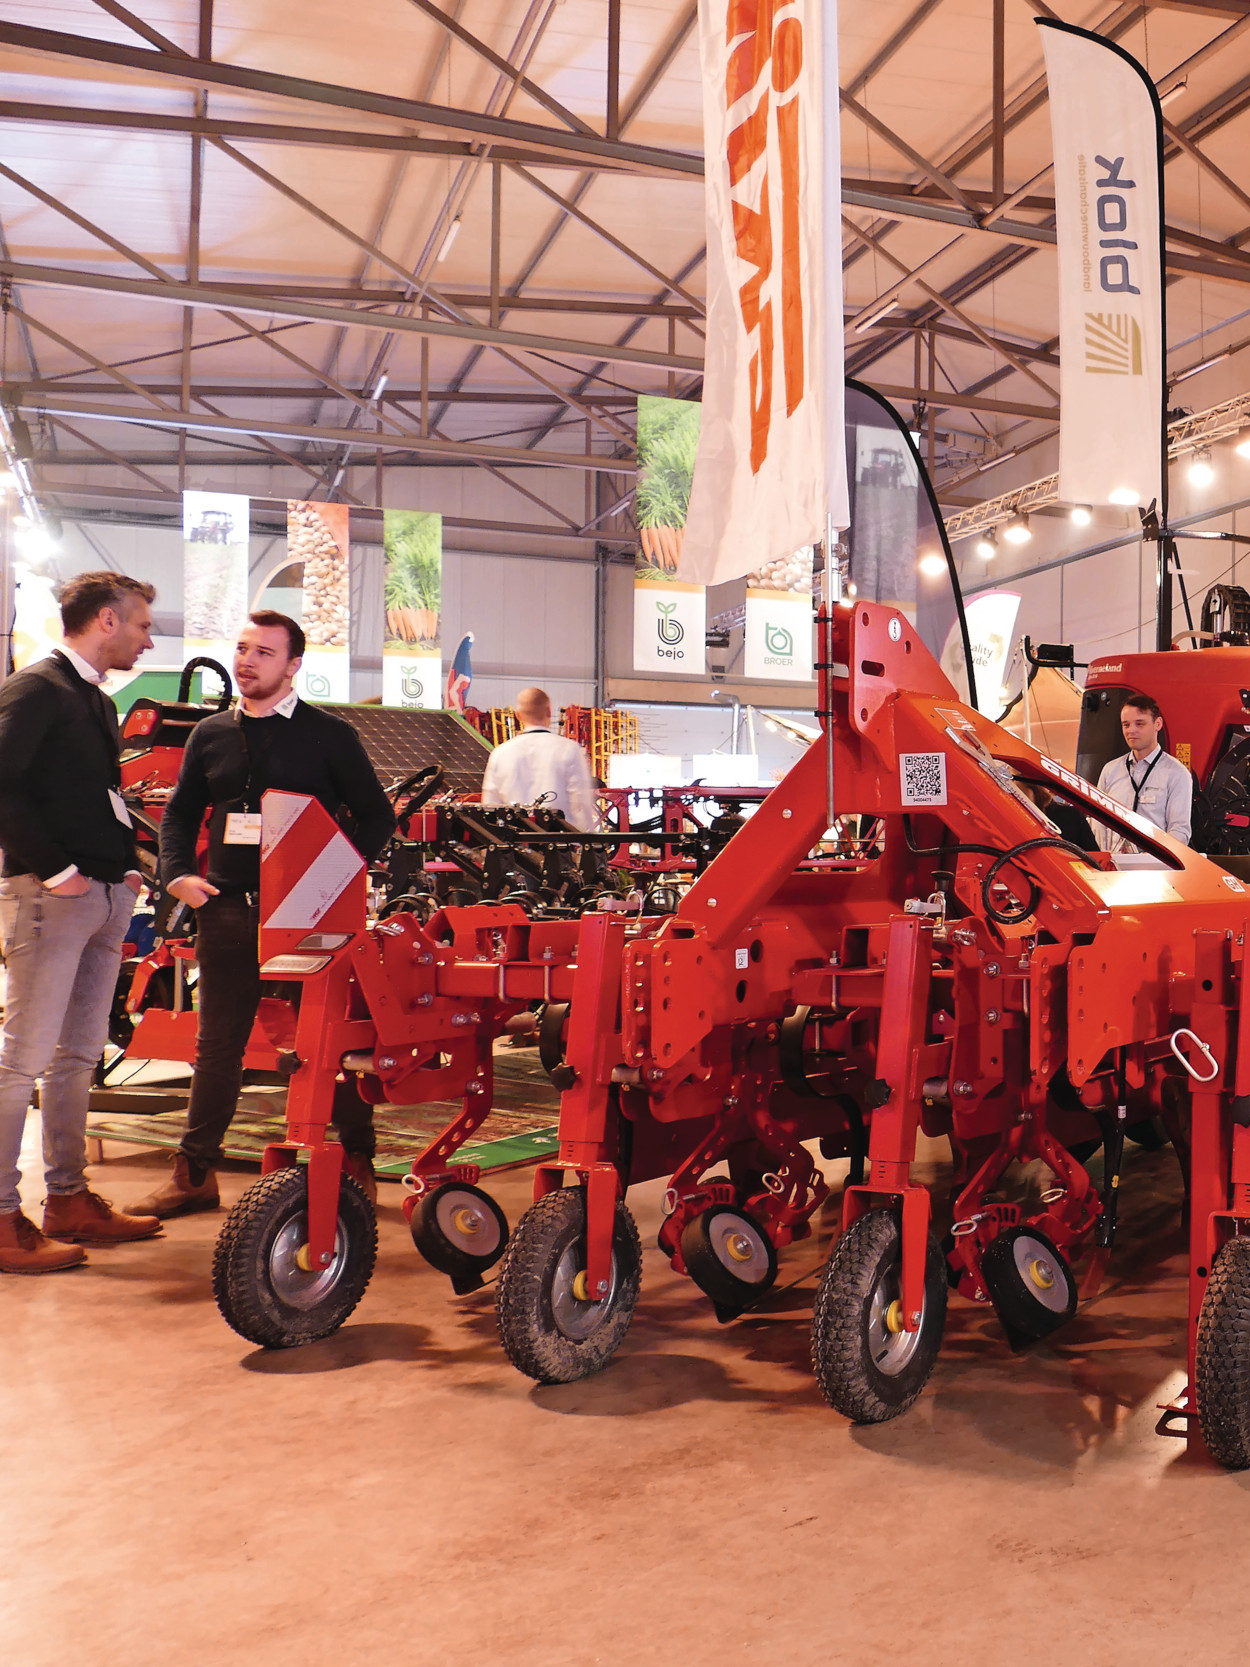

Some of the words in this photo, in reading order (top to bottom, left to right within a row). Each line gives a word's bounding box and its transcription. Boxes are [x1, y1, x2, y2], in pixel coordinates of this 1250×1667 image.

[657, 646, 685, 660] bejo
[764, 657, 793, 667] BROER
[401, 699, 424, 709] bejo
[1041, 754, 1140, 826] GRIMM
